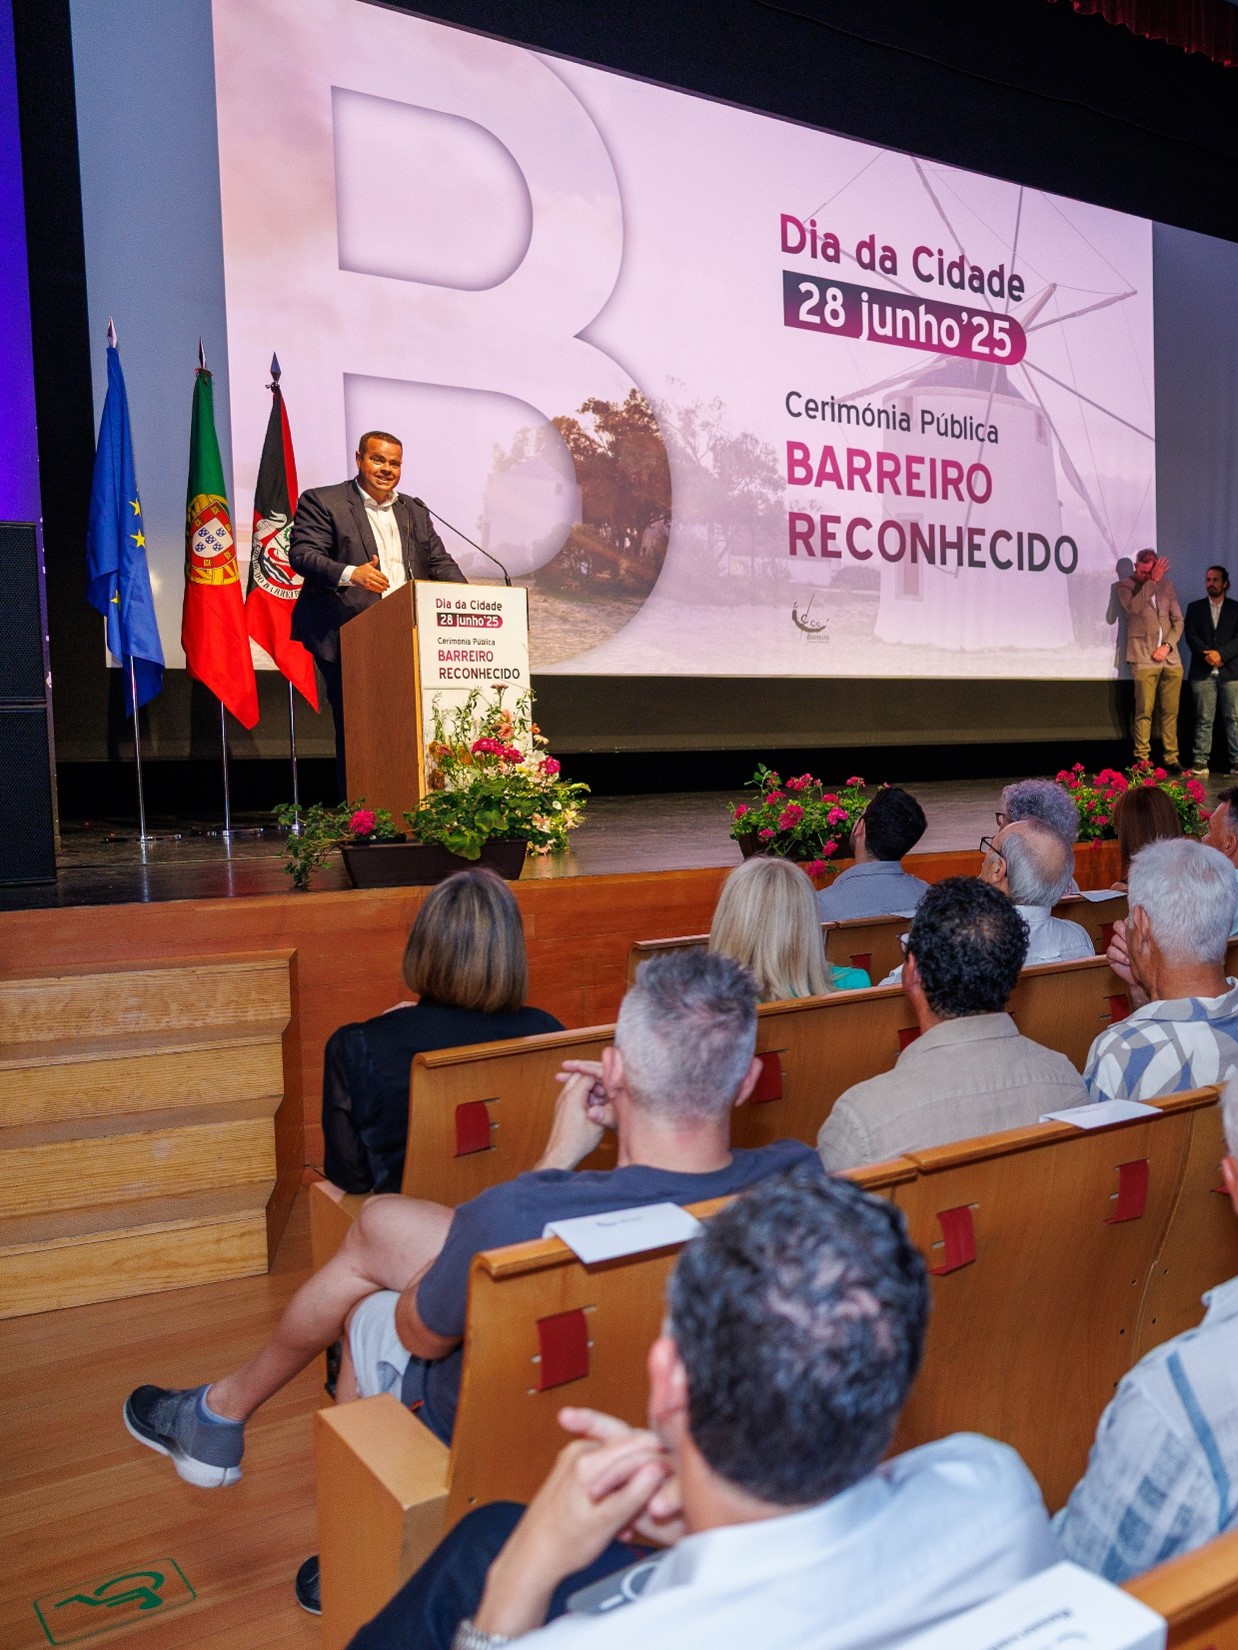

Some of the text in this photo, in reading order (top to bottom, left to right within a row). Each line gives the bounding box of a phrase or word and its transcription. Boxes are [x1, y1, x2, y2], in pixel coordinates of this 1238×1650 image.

[780, 213, 1025, 302] Dia da Cidade
[798, 281, 1012, 358] 28 junho'25
[785, 391, 999, 444] Cerimónia Pública
[786, 440, 993, 504] BARREIRO
[788, 511, 1079, 575] RECONHECIDO
[262, 583, 301, 599] BARREIR
[436, 598, 503, 612] Dia da Cidade
[440, 614, 499, 628] 28 junho'25
[438, 649, 494, 662] BARREIRO
[439, 667, 521, 680] RECONHECIDO
